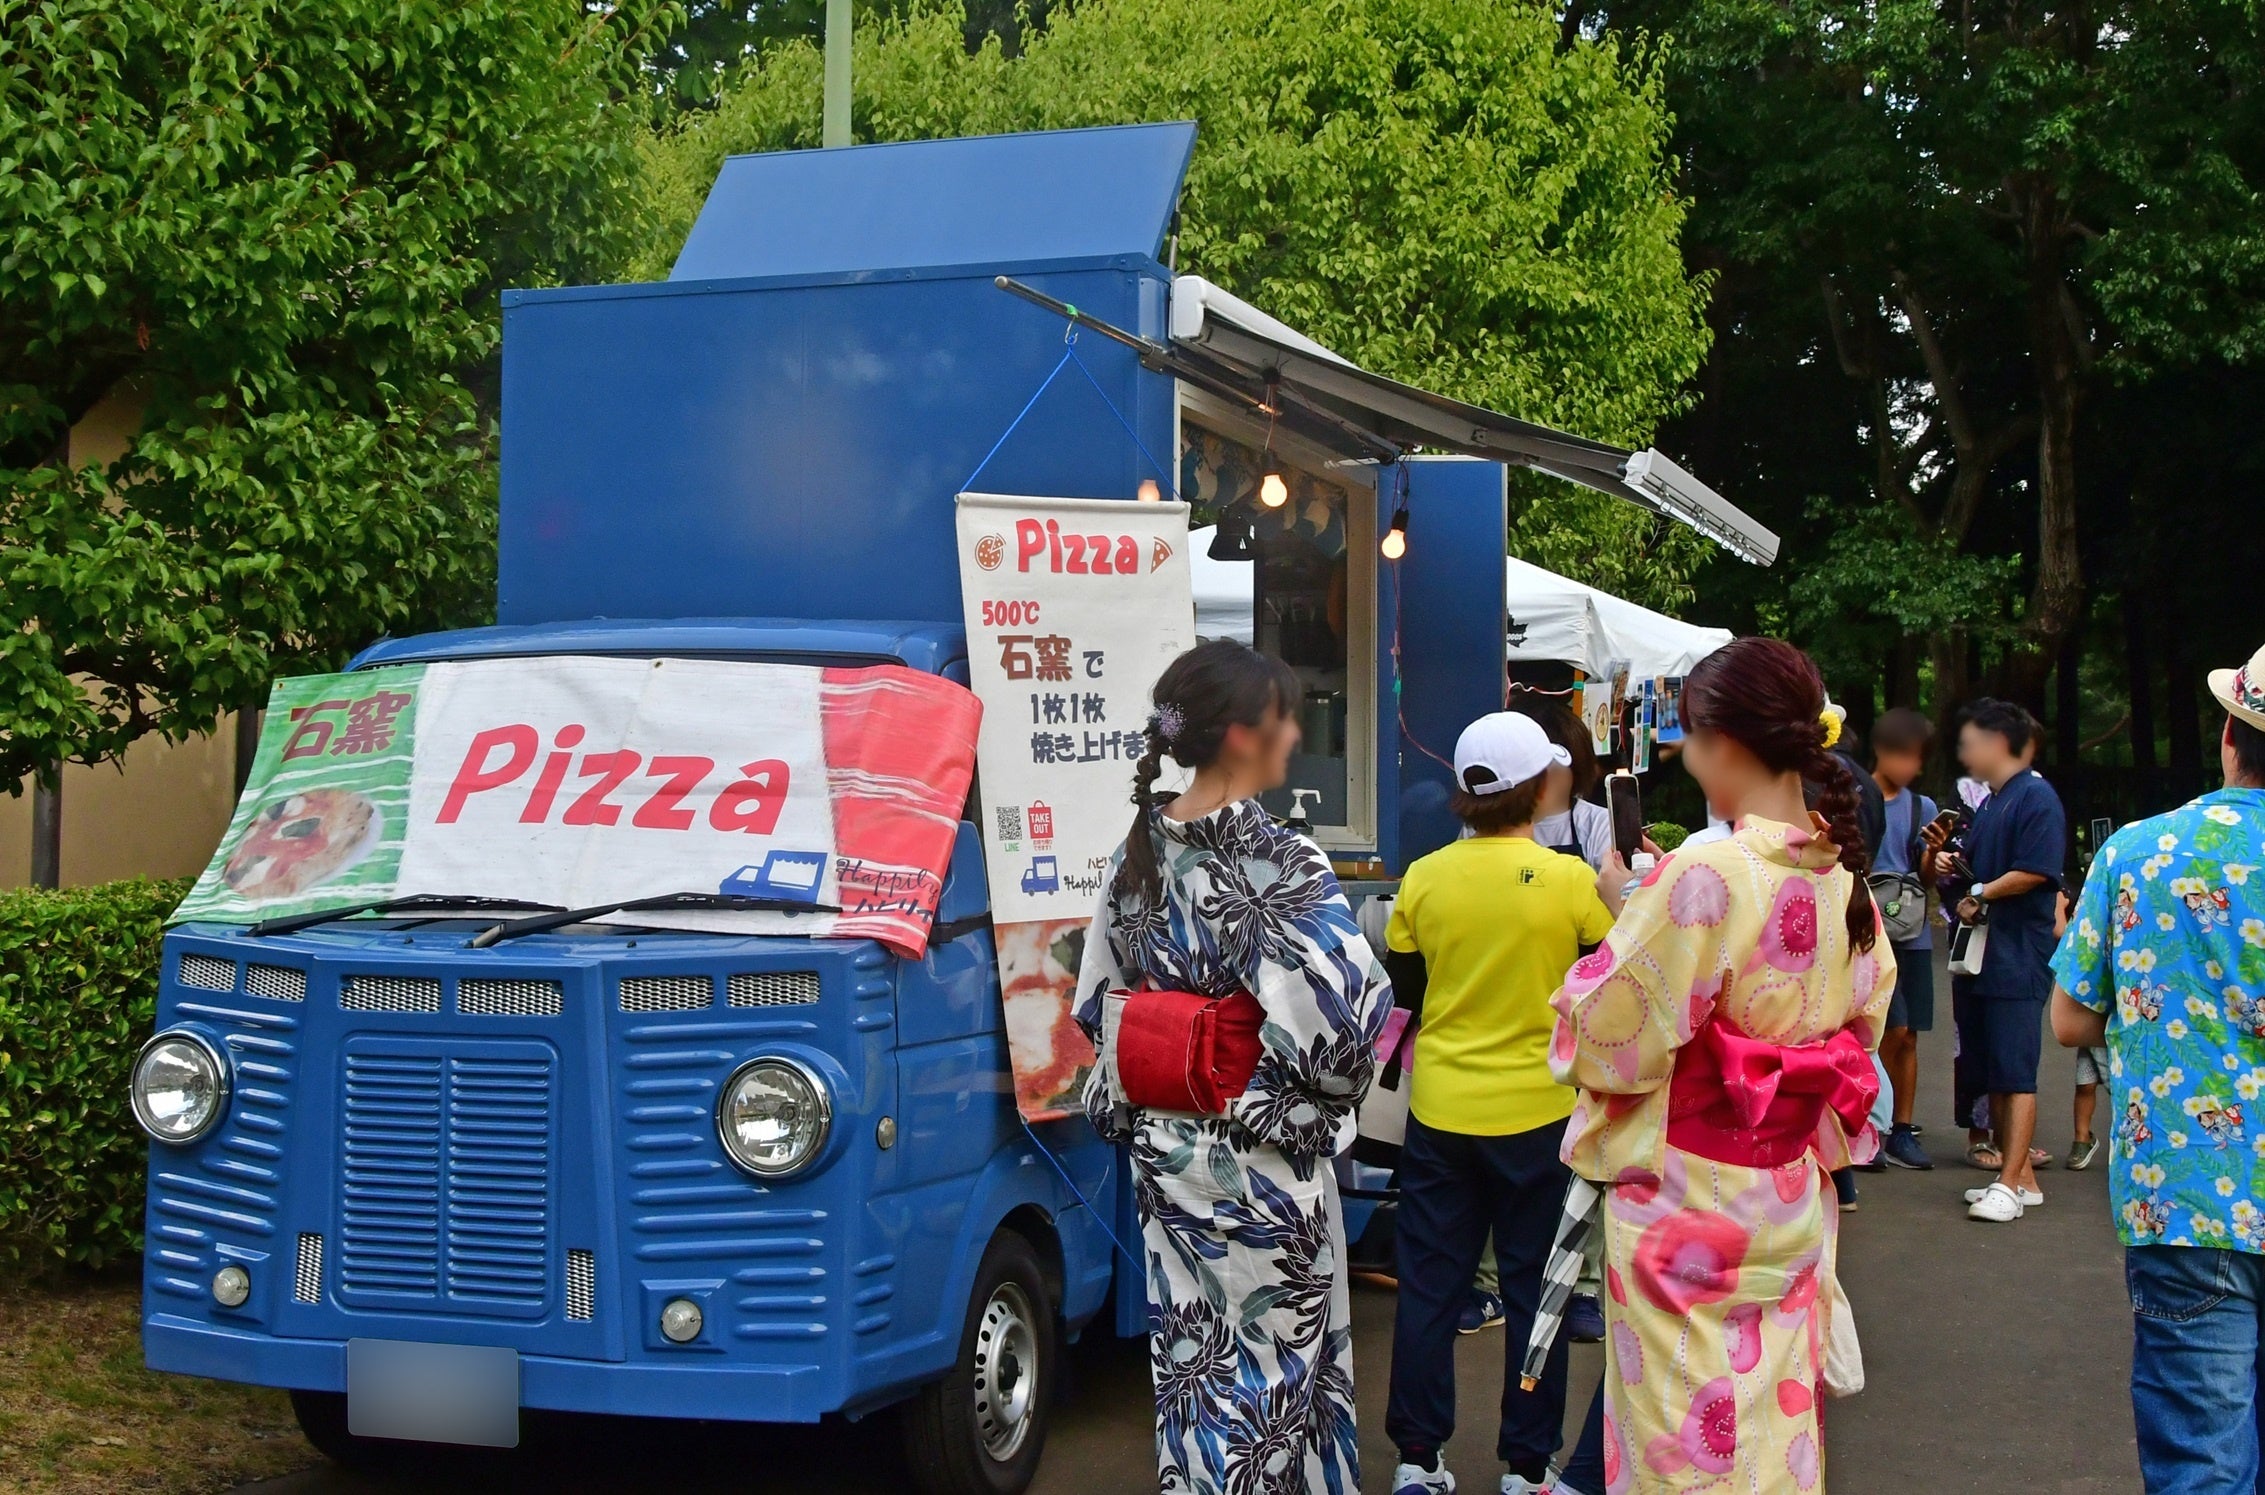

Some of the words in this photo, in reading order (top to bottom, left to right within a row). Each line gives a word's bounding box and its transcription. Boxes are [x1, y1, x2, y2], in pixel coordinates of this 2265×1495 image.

[1016, 518, 1139, 575] Pizza
[1030, 692, 1106, 725] 1枚1枚
[281, 690, 412, 764] 石窯
[1030, 730, 1147, 764] 焼き上げま
[435, 723, 791, 835] Pizza
[1030, 812, 1050, 824] TAKE
[1033, 824, 1049, 834] OUT
[1004, 842, 1020, 852] LINE
[836, 858, 939, 904] Happily
[1063, 870, 1103, 897] Happil
